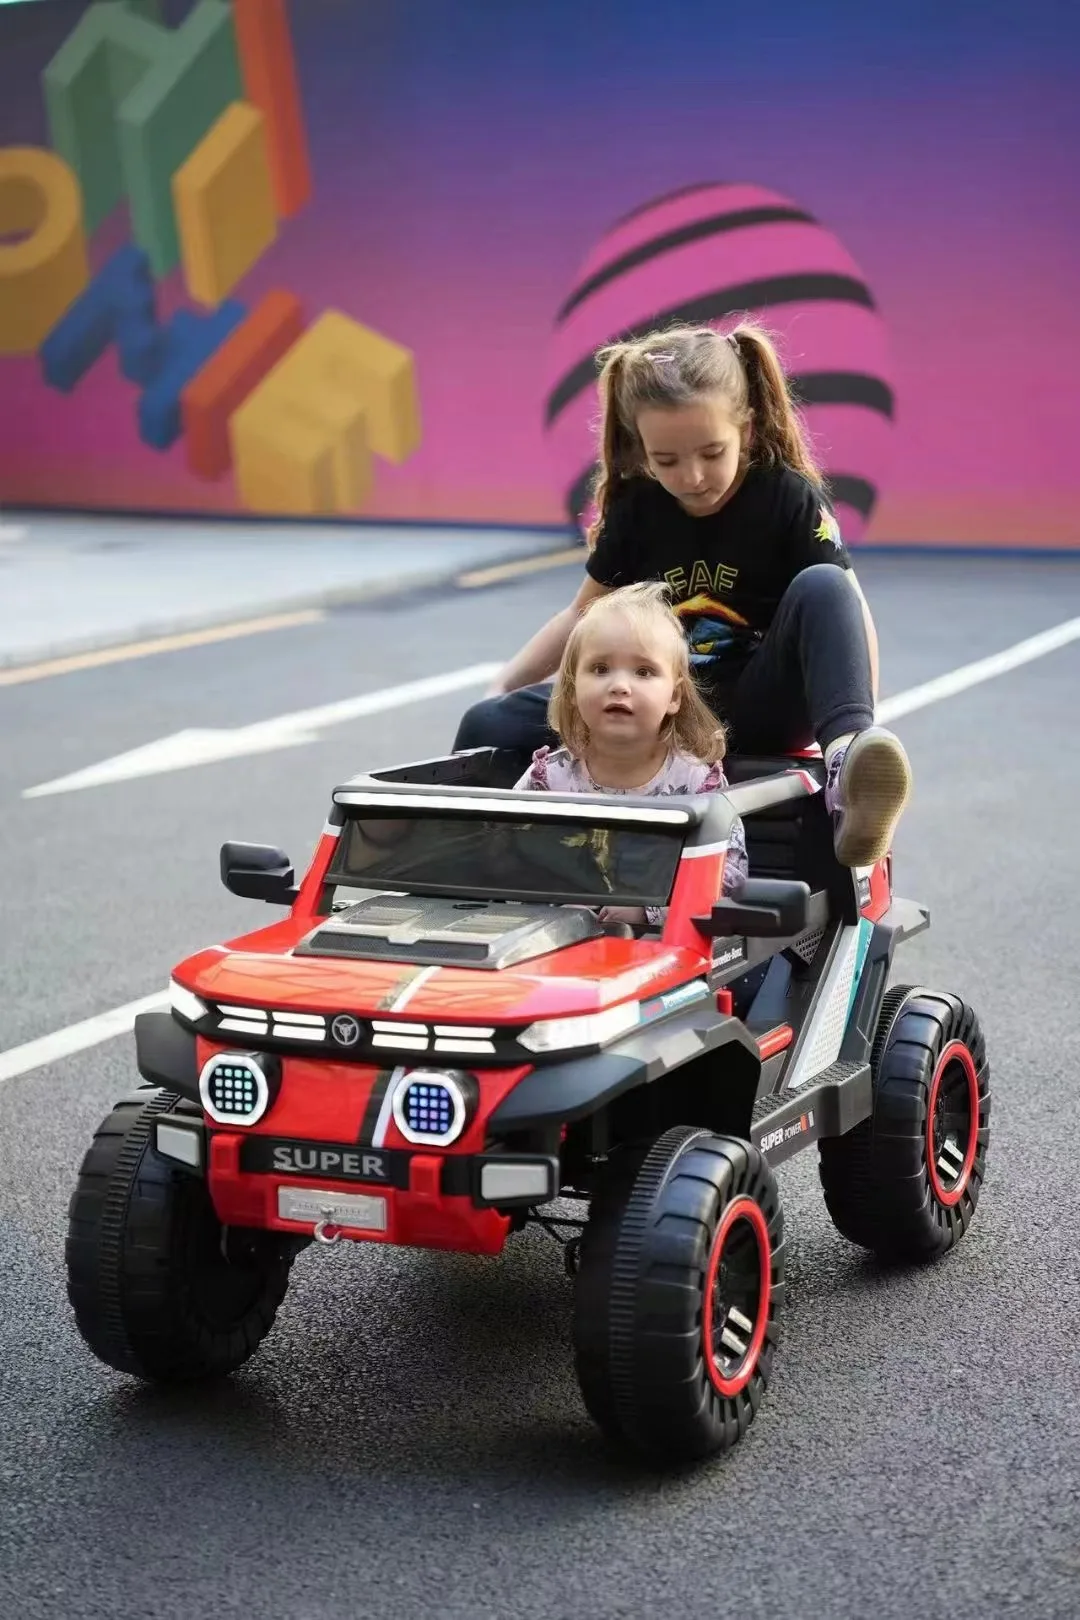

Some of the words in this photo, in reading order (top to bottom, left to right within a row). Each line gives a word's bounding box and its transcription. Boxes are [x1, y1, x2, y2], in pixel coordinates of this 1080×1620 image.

[760, 1127, 784, 1153] SUPER
[784, 1121, 802, 1141] POWER
[273, 1146, 386, 1177] SUPER
